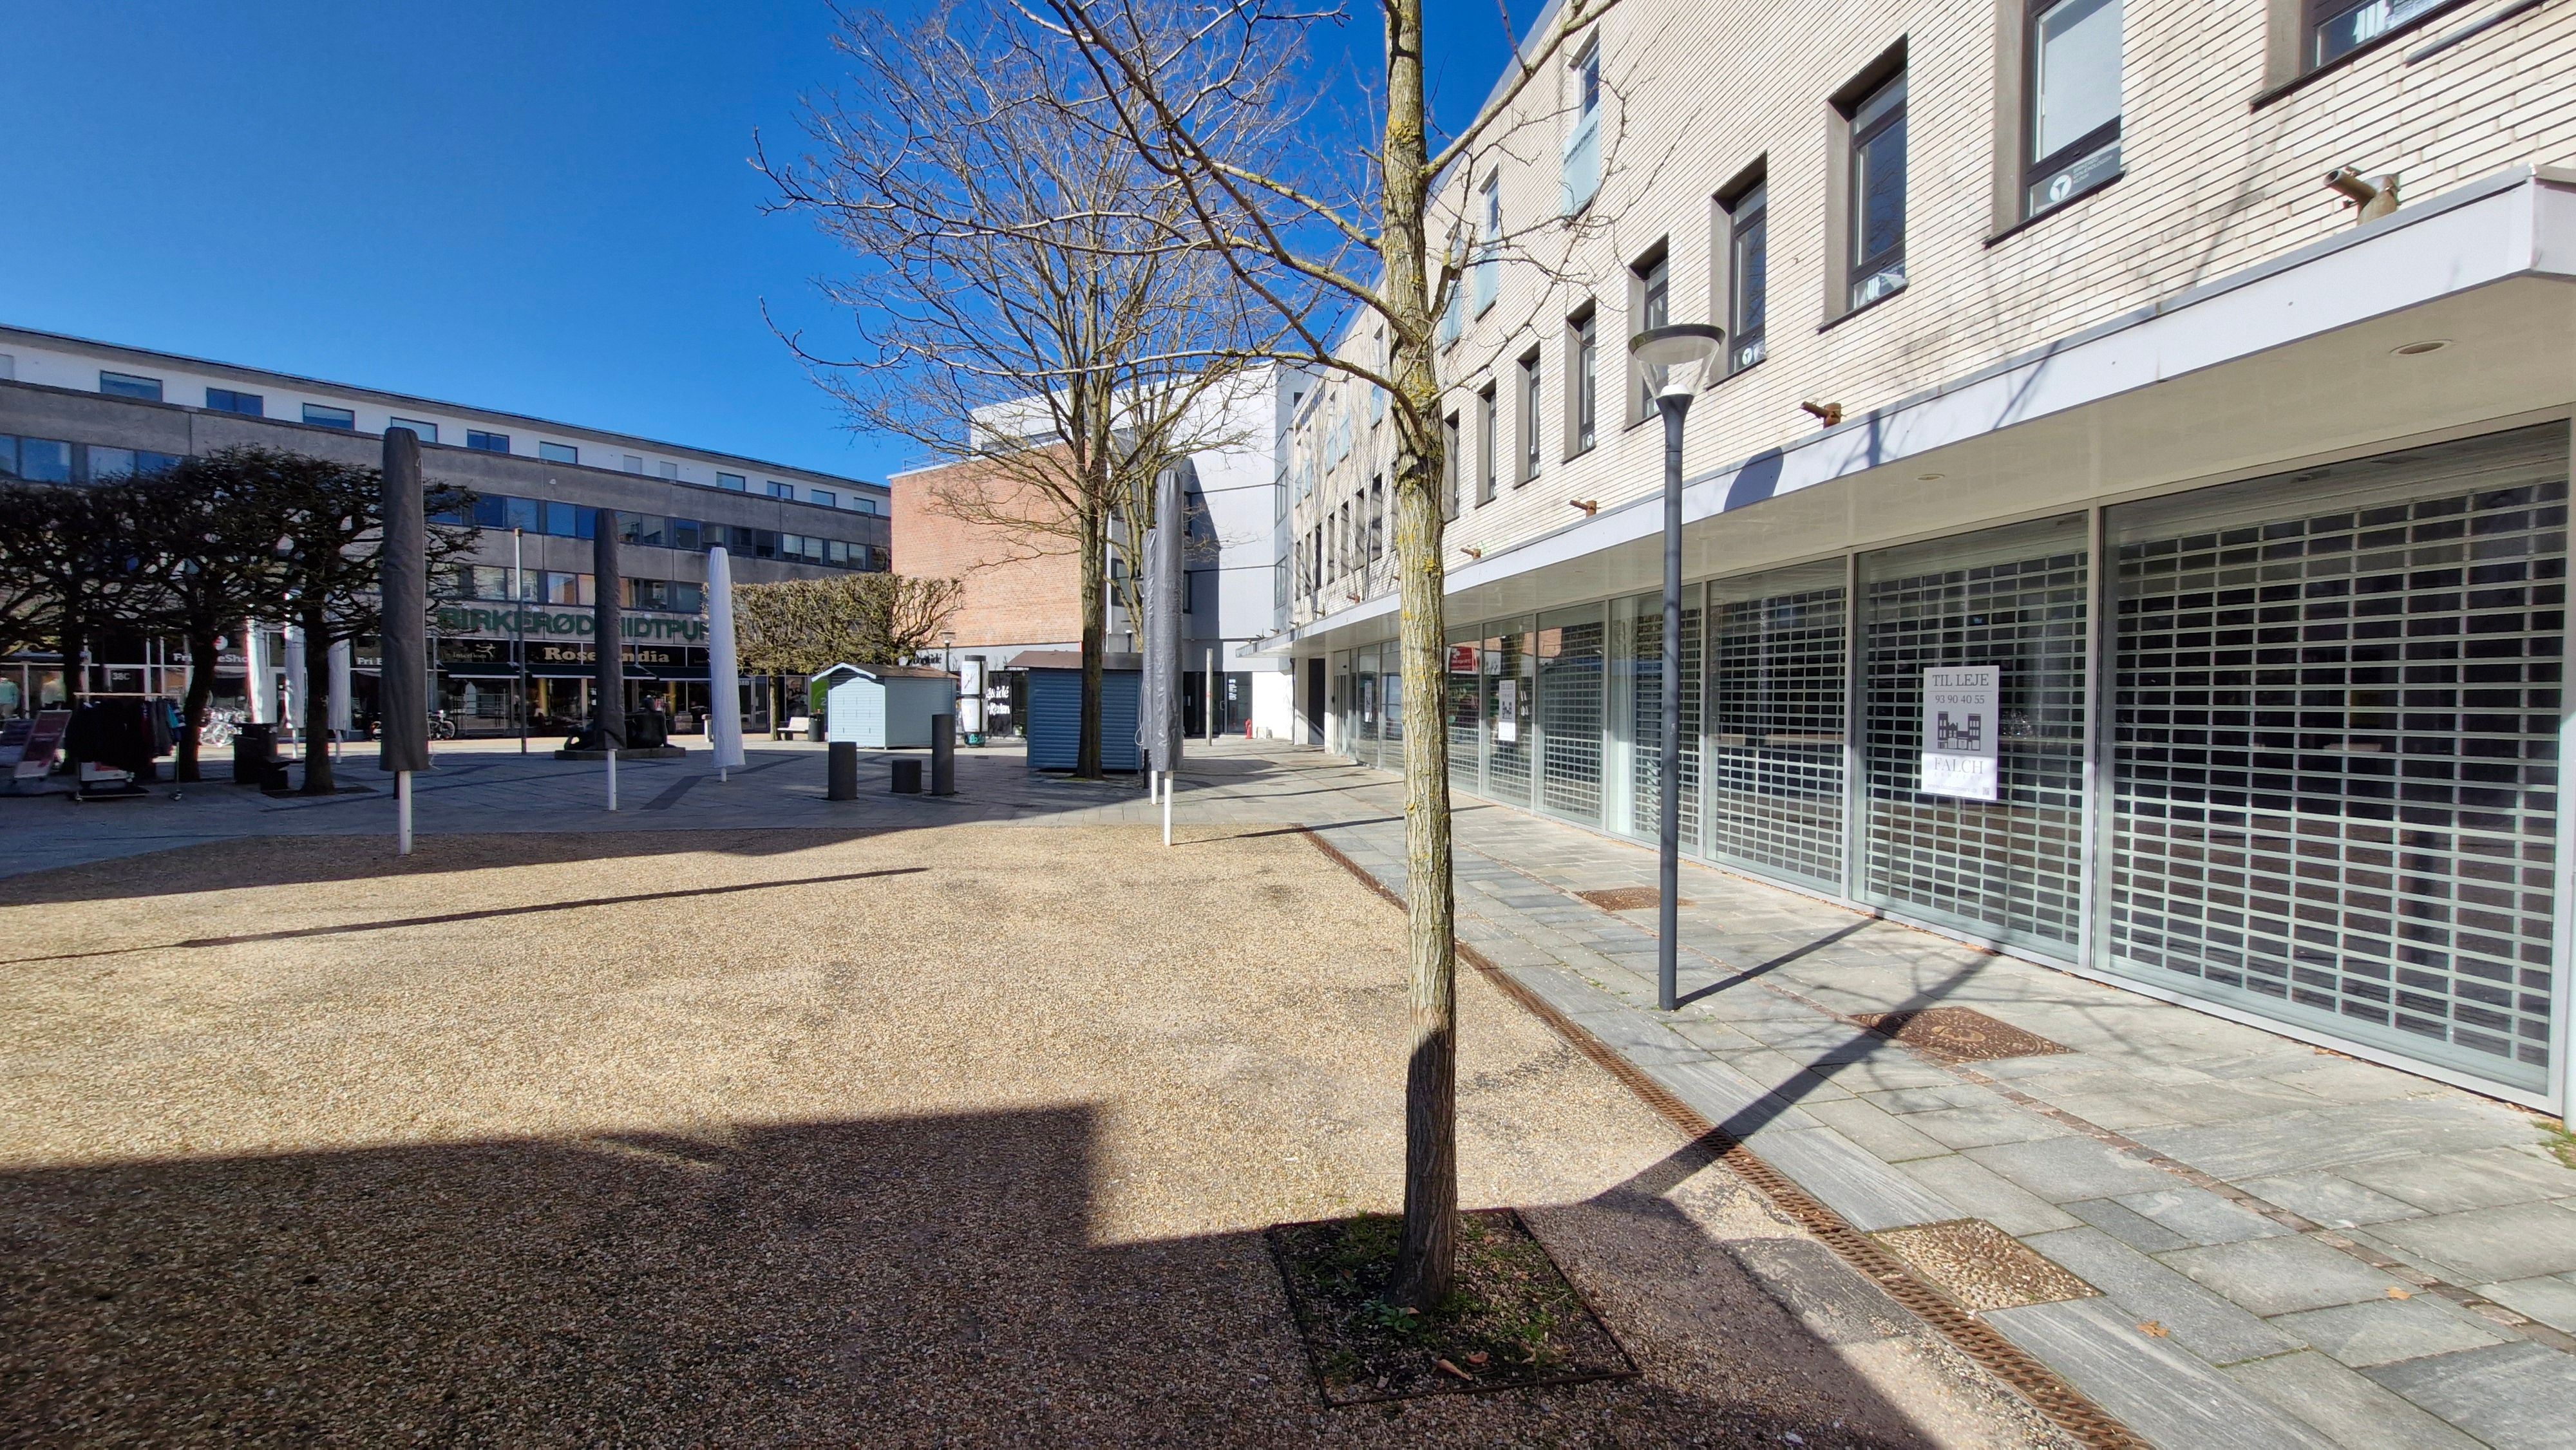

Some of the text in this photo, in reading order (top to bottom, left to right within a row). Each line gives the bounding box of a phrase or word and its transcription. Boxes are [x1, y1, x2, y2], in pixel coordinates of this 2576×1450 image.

[437, 608, 595, 636] BIRKERØD
[1932, 673, 1989, 686] TIL LEJE
[1935, 695, 1985, 704] 93 90 40 55
[1934, 757, 1984, 774] FALCH
